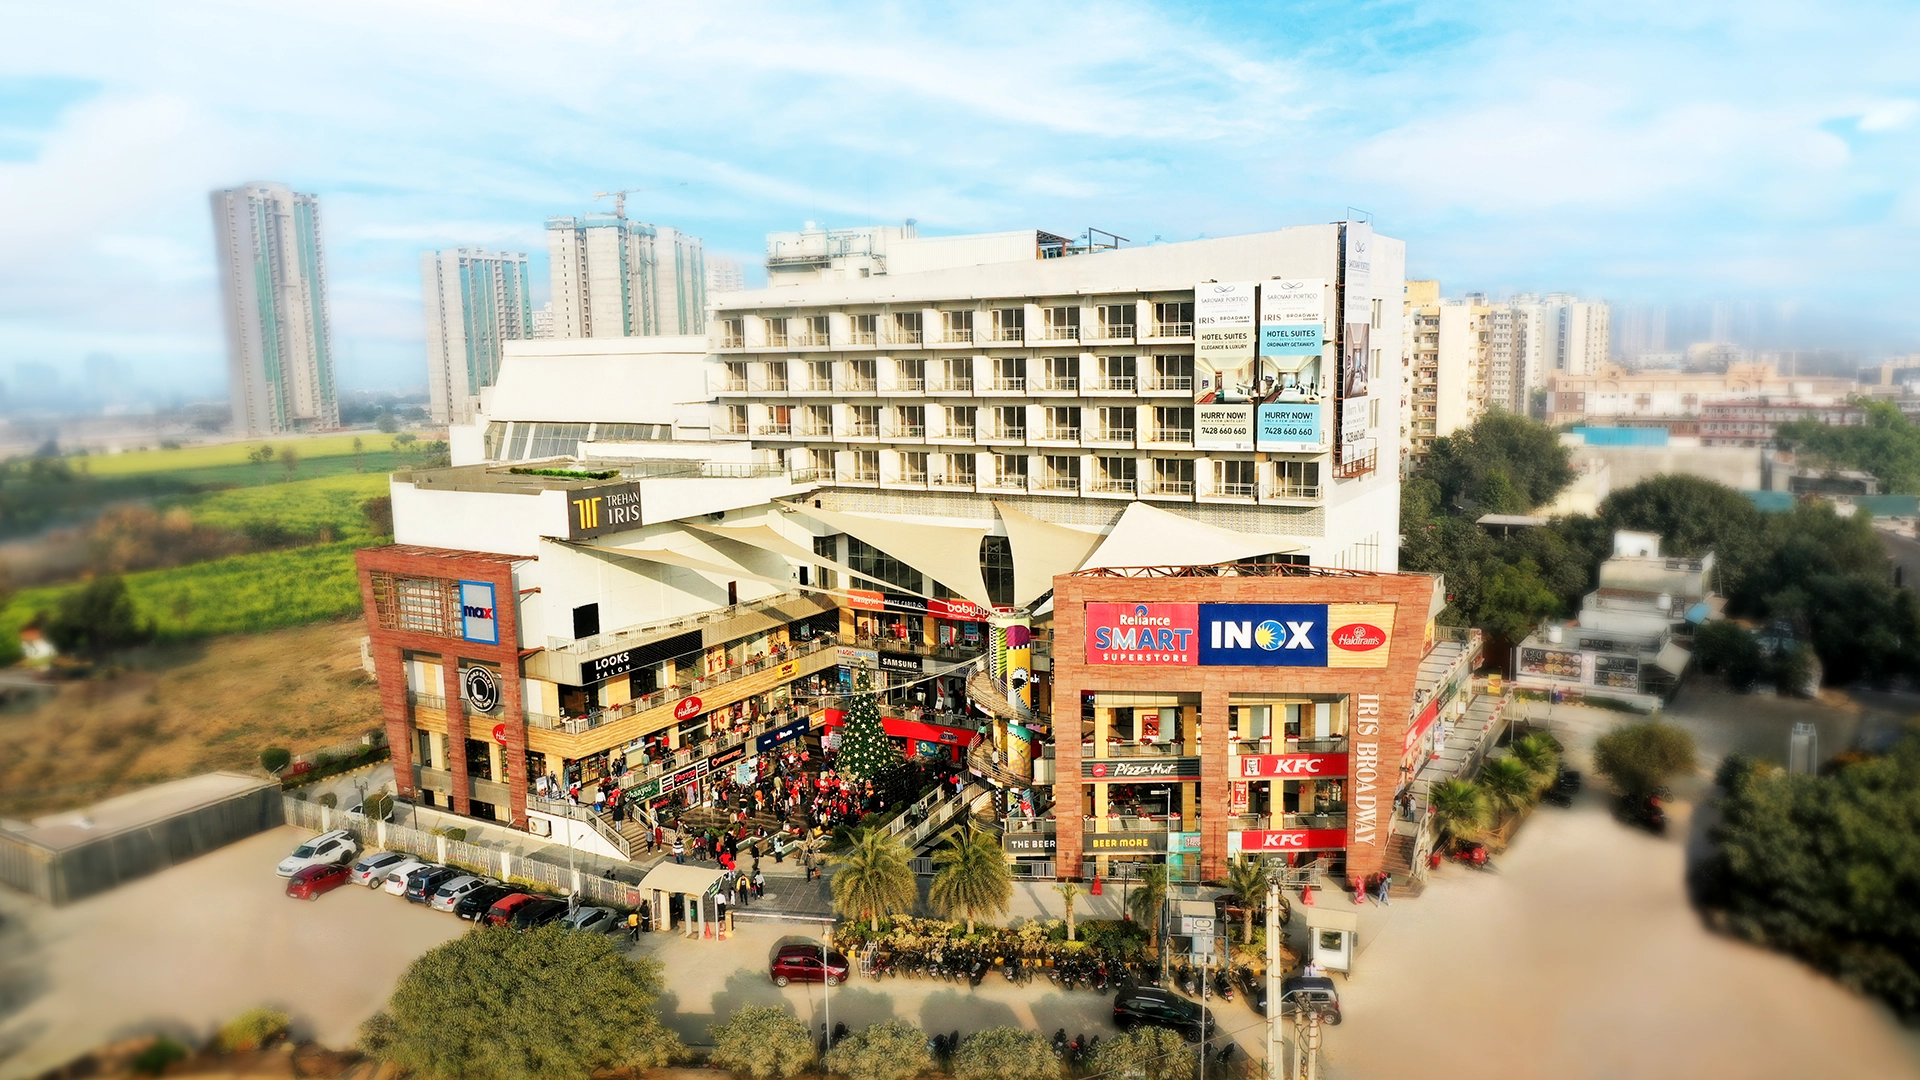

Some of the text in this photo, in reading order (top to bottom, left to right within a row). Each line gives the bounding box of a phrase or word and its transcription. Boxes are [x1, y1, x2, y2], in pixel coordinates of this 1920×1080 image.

[606, 492, 639, 507] TREHAN
[608, 505, 640, 525] IRIS
[464, 605, 493, 620] max
[1120, 613, 1170, 626] Reliance
[1095, 627, 1193, 651] SMART
[1211, 620, 1315, 651] INOX
[1338, 633, 1380, 646] Haldiram's
[595, 652, 629, 670] LOOKS
[882, 658, 917, 669] SAMSUNG
[1103, 653, 1188, 662] SUPERSTORE
[596, 664, 631, 679] SALON
[468, 671, 493, 689] LOOKS SALON
[1114, 763, 1177, 776] Pizza Hut
[1274, 758, 1321, 774] KFC
[1354, 693, 1380, 846] IRIS BROADWAY
[1032, 840, 1056, 848] BEER
[1093, 838, 1148, 848] BEER MORE
[1264, 834, 1304, 846] KFC
